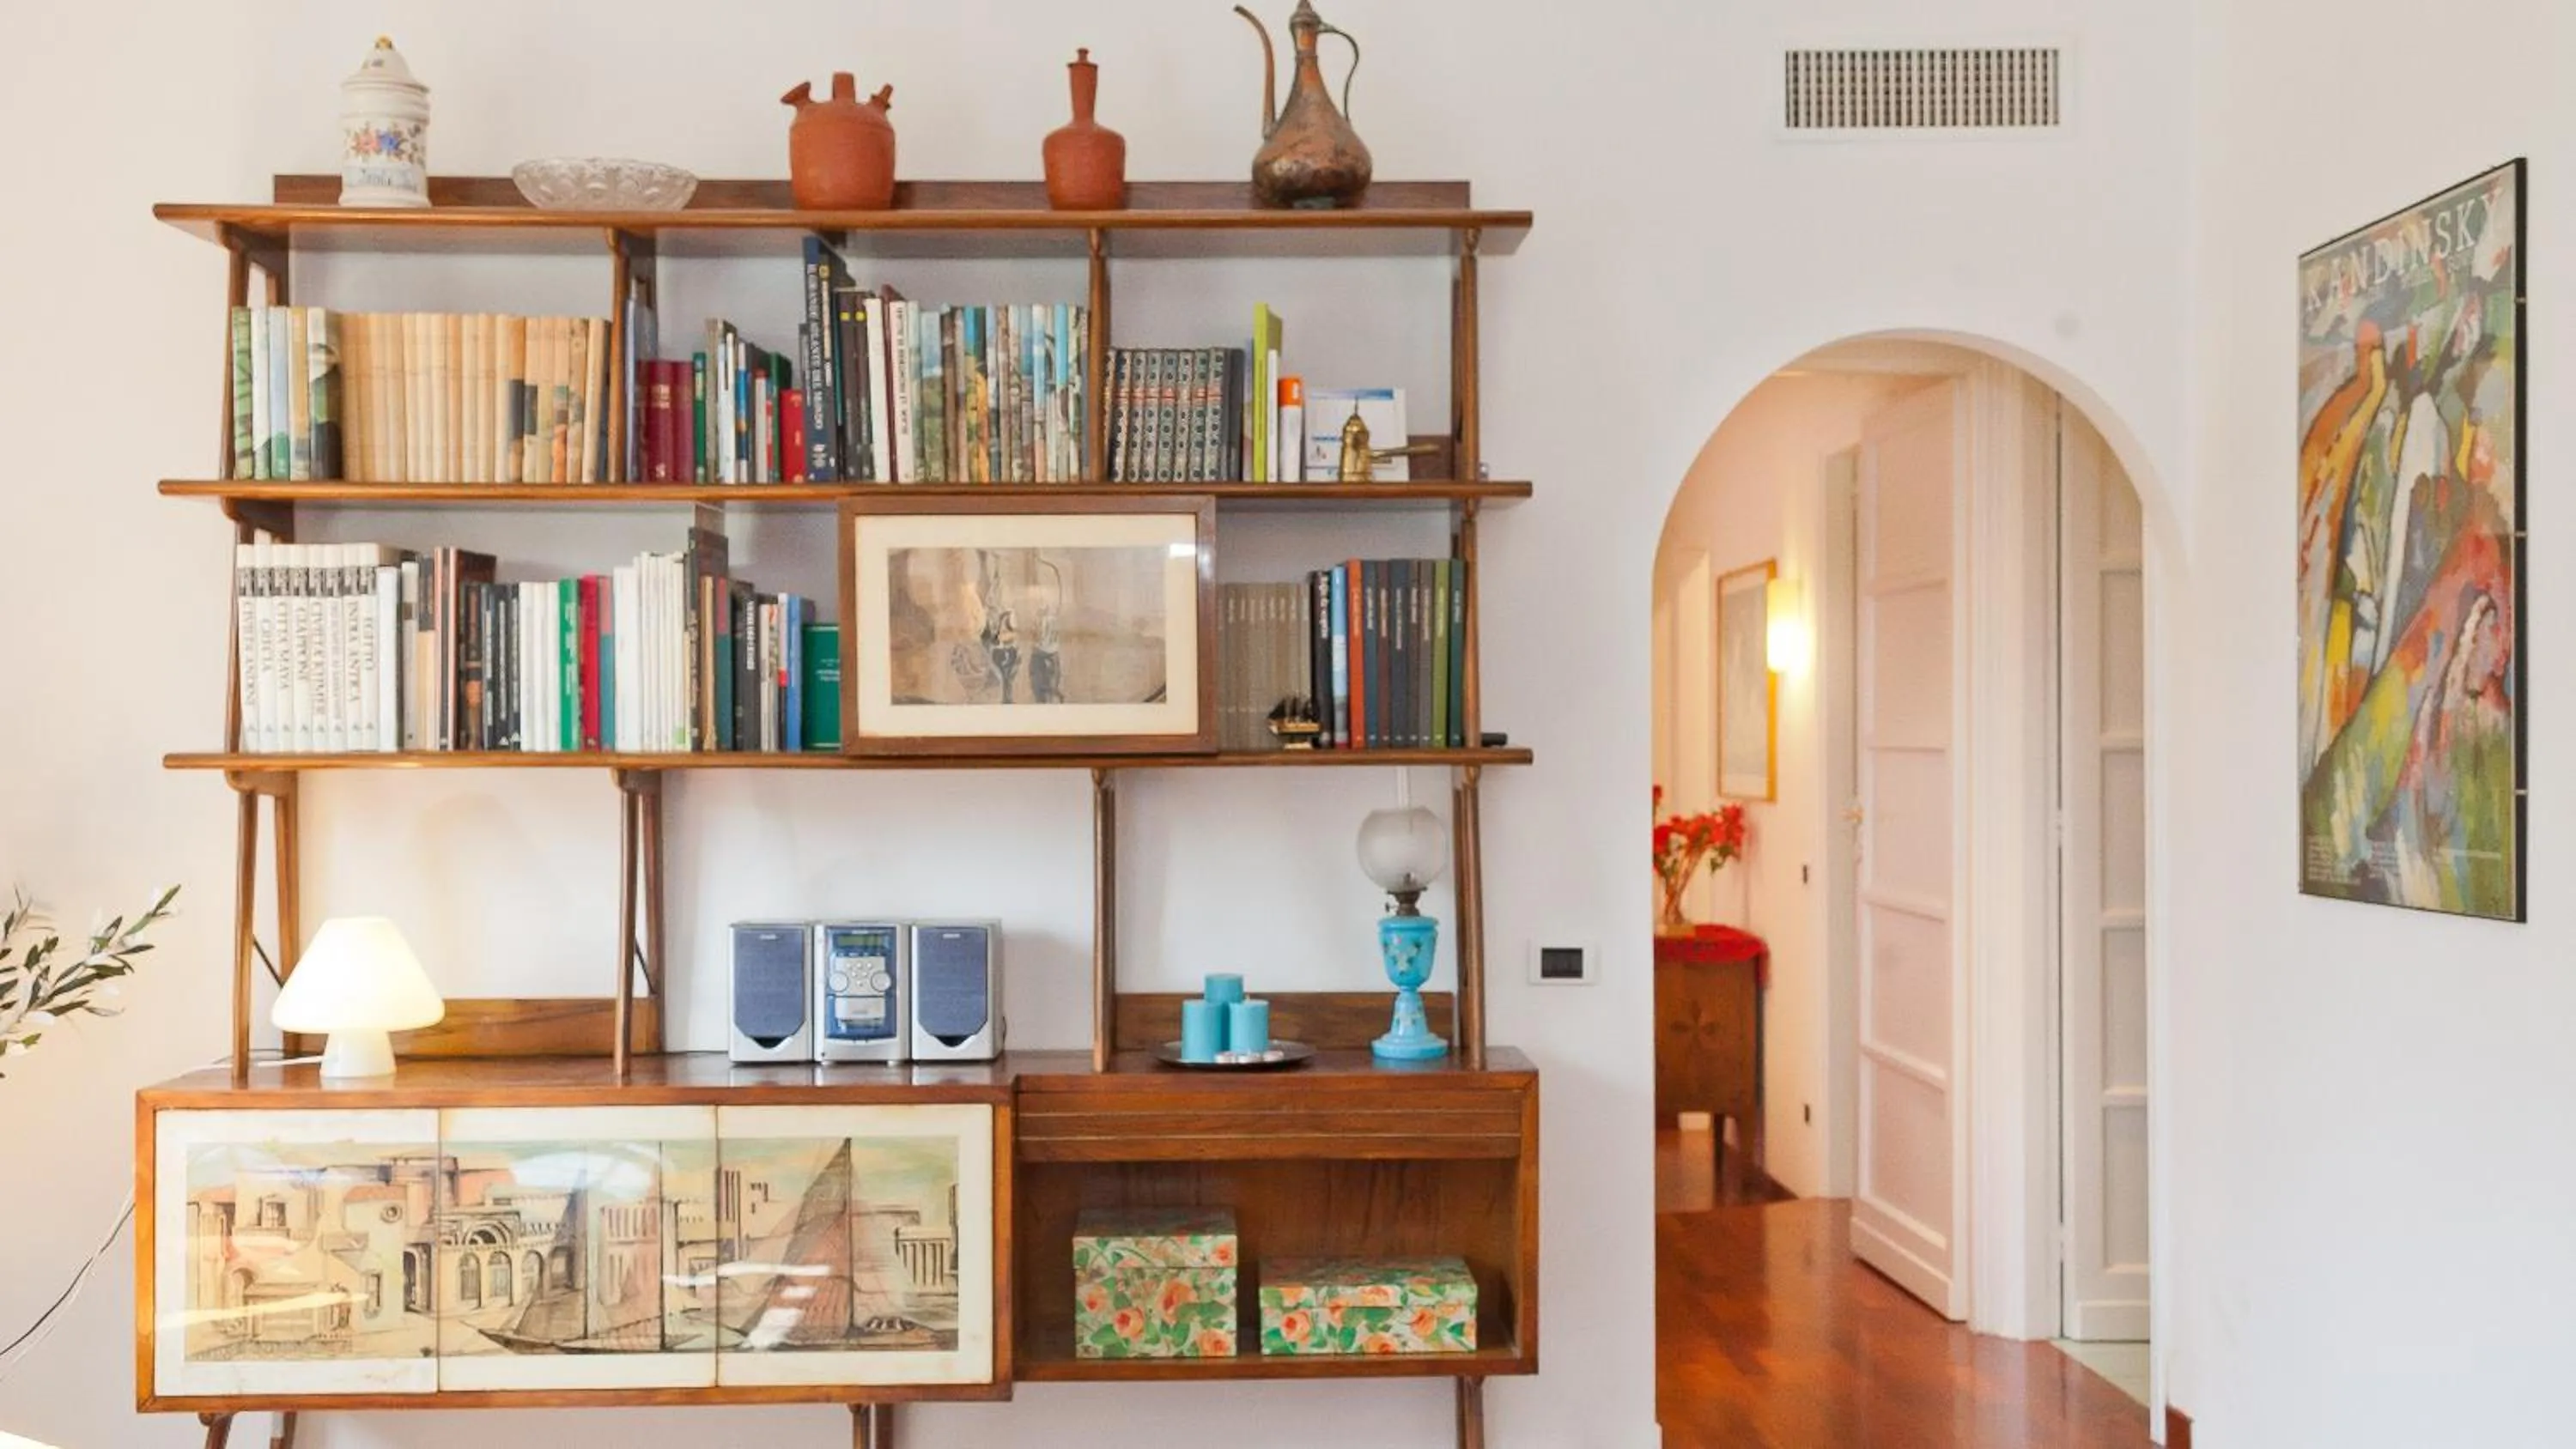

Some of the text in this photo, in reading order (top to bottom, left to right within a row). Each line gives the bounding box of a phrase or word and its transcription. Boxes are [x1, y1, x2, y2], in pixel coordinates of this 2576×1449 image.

[2305, 186, 2505, 312] KANDINSKY
[348, 601, 360, 701] INDIA ANTICA
